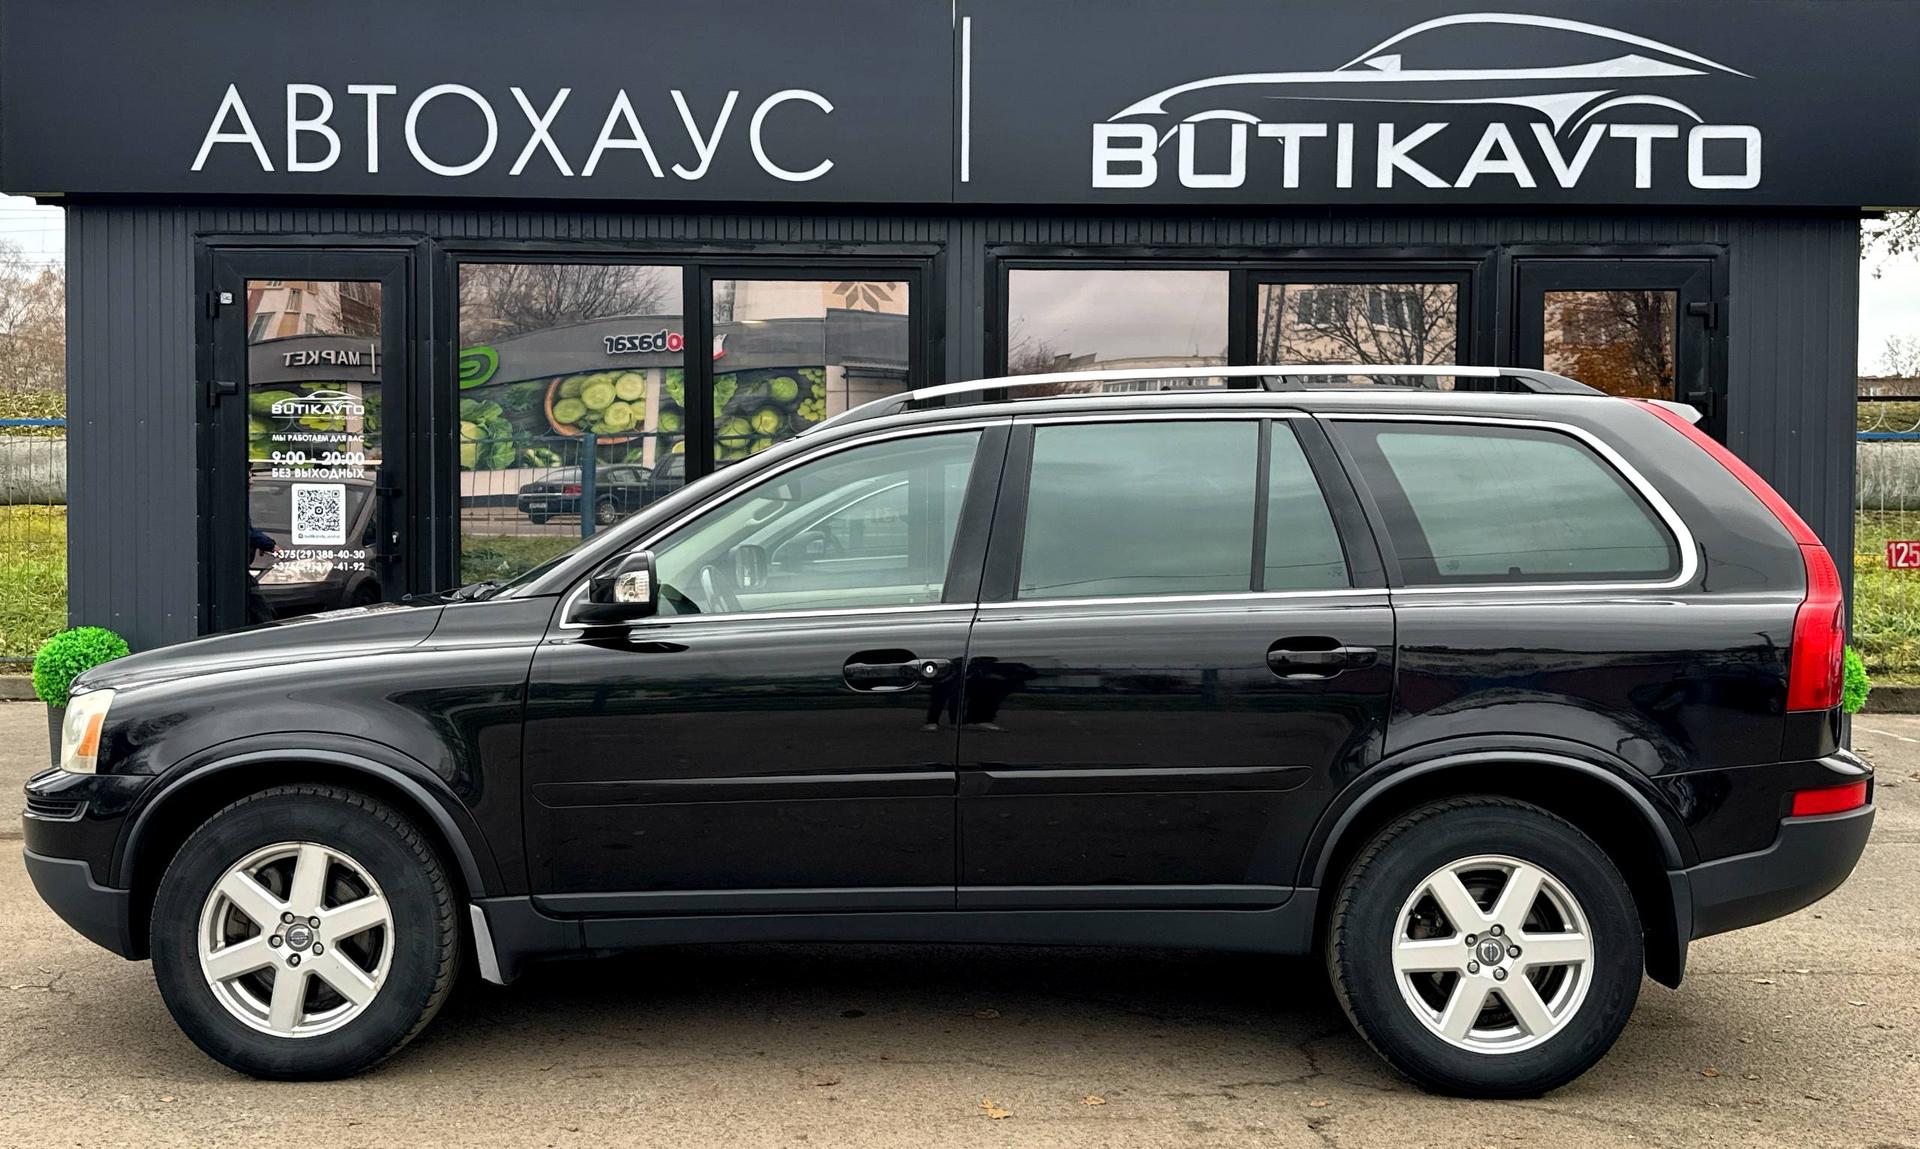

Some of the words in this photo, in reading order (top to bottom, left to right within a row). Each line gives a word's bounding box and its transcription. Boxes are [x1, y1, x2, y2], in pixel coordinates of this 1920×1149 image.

[190, 82, 835, 183] АВТОХАУС
[1091, 121, 1764, 190] BUTIKAVTO
[271, 403, 365, 415] BUTIKAVTO
[272, 434, 286, 442] МЫ
[287, 434, 329, 442] РАБОТАЕМ
[330, 435, 347, 443] ДЛЯ
[348, 435, 365, 443] ВАС
[272, 451, 306, 465] 9:00
[321, 451, 365, 465] 20:00
[272, 467, 291, 478] БЕЗ
[294, 468, 365, 480] ВЫХОДНЫХ
[272, 549, 366, 561] +375(29)388-40-30
[1888, 542, 1920, 568] 125
